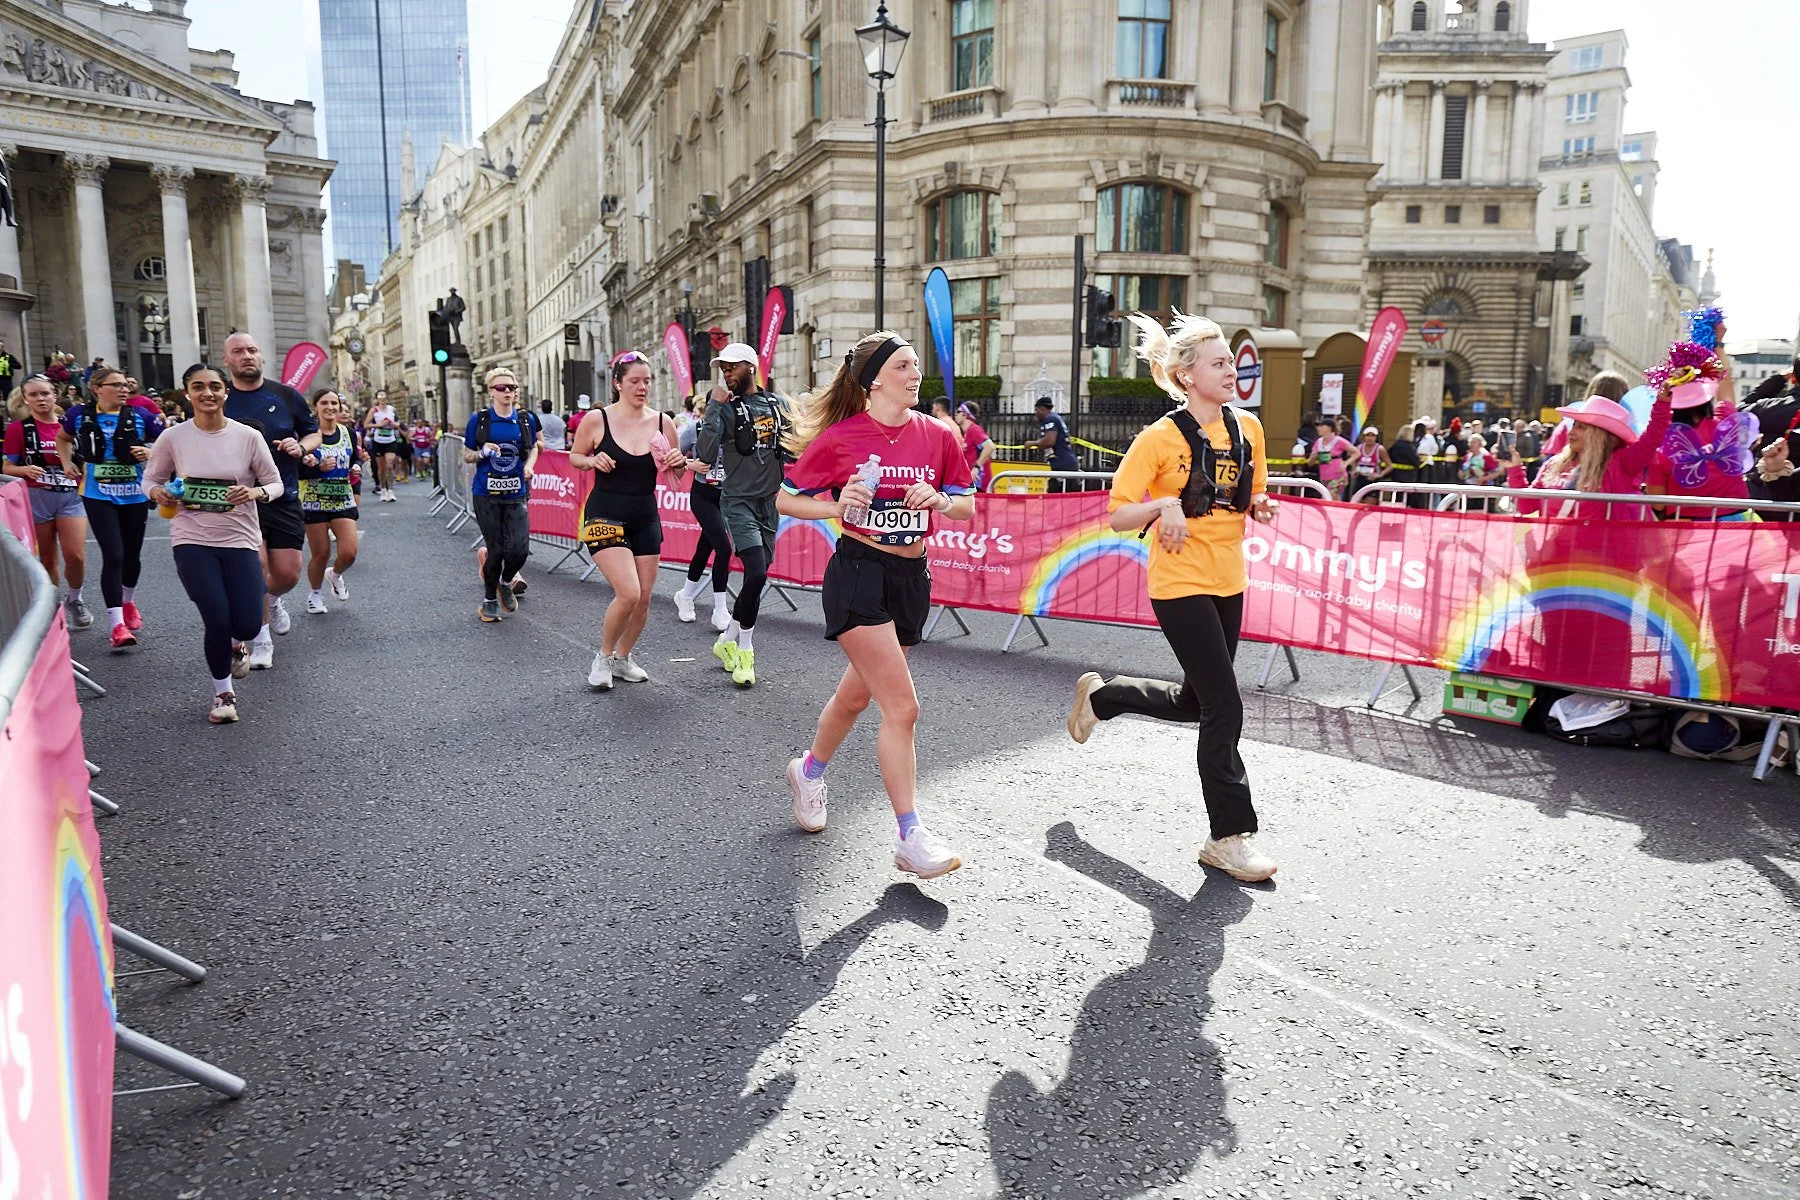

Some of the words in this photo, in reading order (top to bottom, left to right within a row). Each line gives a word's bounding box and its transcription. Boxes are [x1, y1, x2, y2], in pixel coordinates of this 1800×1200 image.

[761, 303, 780, 358] Tommy's
[1365, 321, 1397, 379] Tommy's
[286, 351, 316, 387] Tommy's
[101, 466, 131, 476] 7329
[1217, 464, 1238, 482] 75
[489, 480, 519, 489] 20332
[531, 473, 576, 497] ommy's
[189, 487, 228, 501] 7553
[866, 511, 921, 529] 10901
[588, 525, 616, 538] 4889
[933, 559, 951, 567] and
[953, 559, 976, 572] baby
[977, 564, 1011, 575] charity
[1242, 534, 1426, 592] ommy's
[1304, 588, 1332, 600] and
[1335, 591, 1373, 610] baby
[1375, 599, 1422, 619] charity
